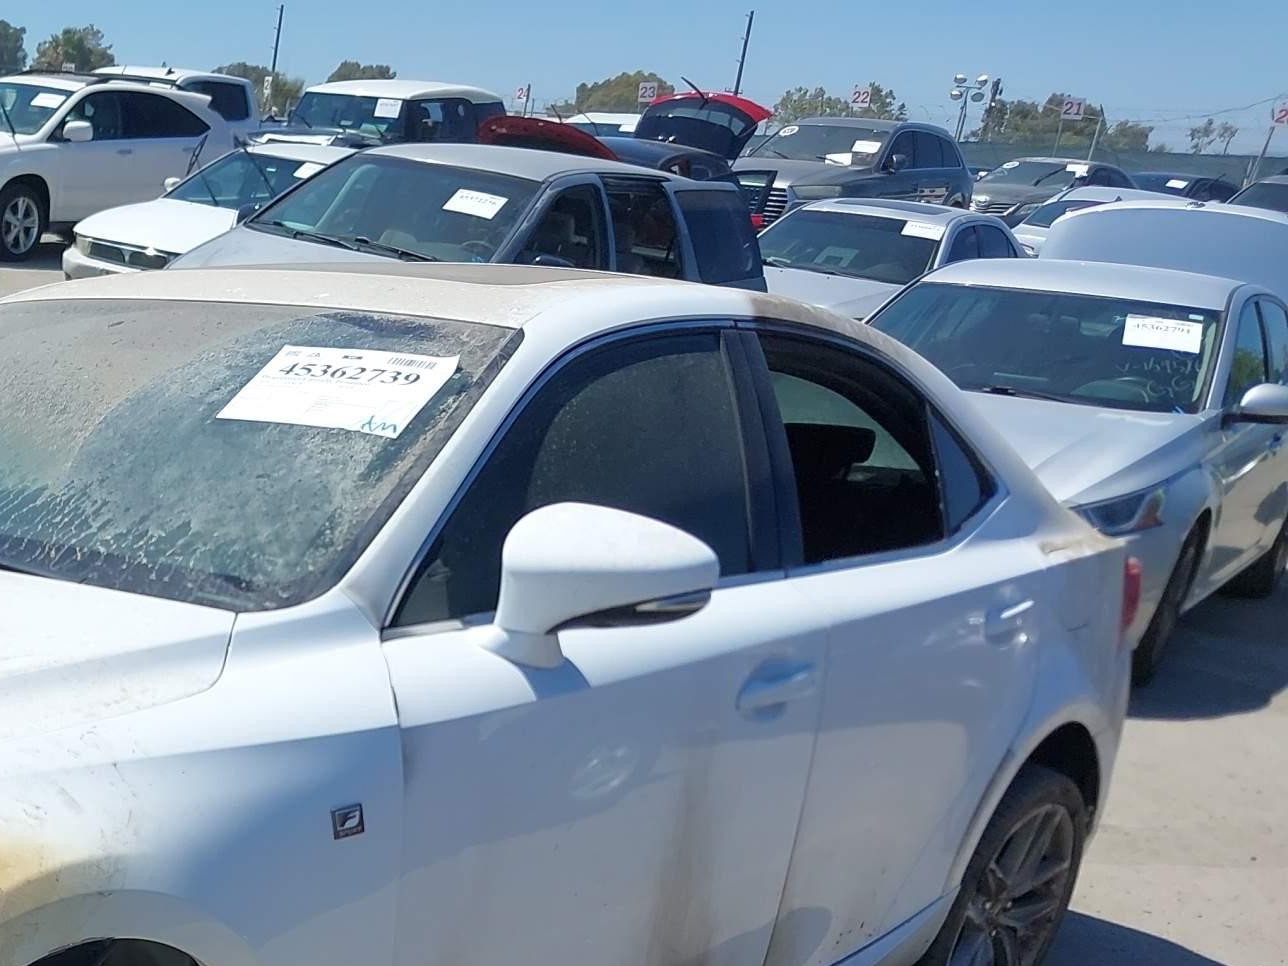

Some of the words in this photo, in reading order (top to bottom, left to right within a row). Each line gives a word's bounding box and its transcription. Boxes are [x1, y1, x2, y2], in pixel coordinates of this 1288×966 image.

[639, 86, 656, 99] 23
[851, 90, 870, 104] 22
[1063, 101, 1082, 116] 21
[279, 362, 421, 386] 45362739
